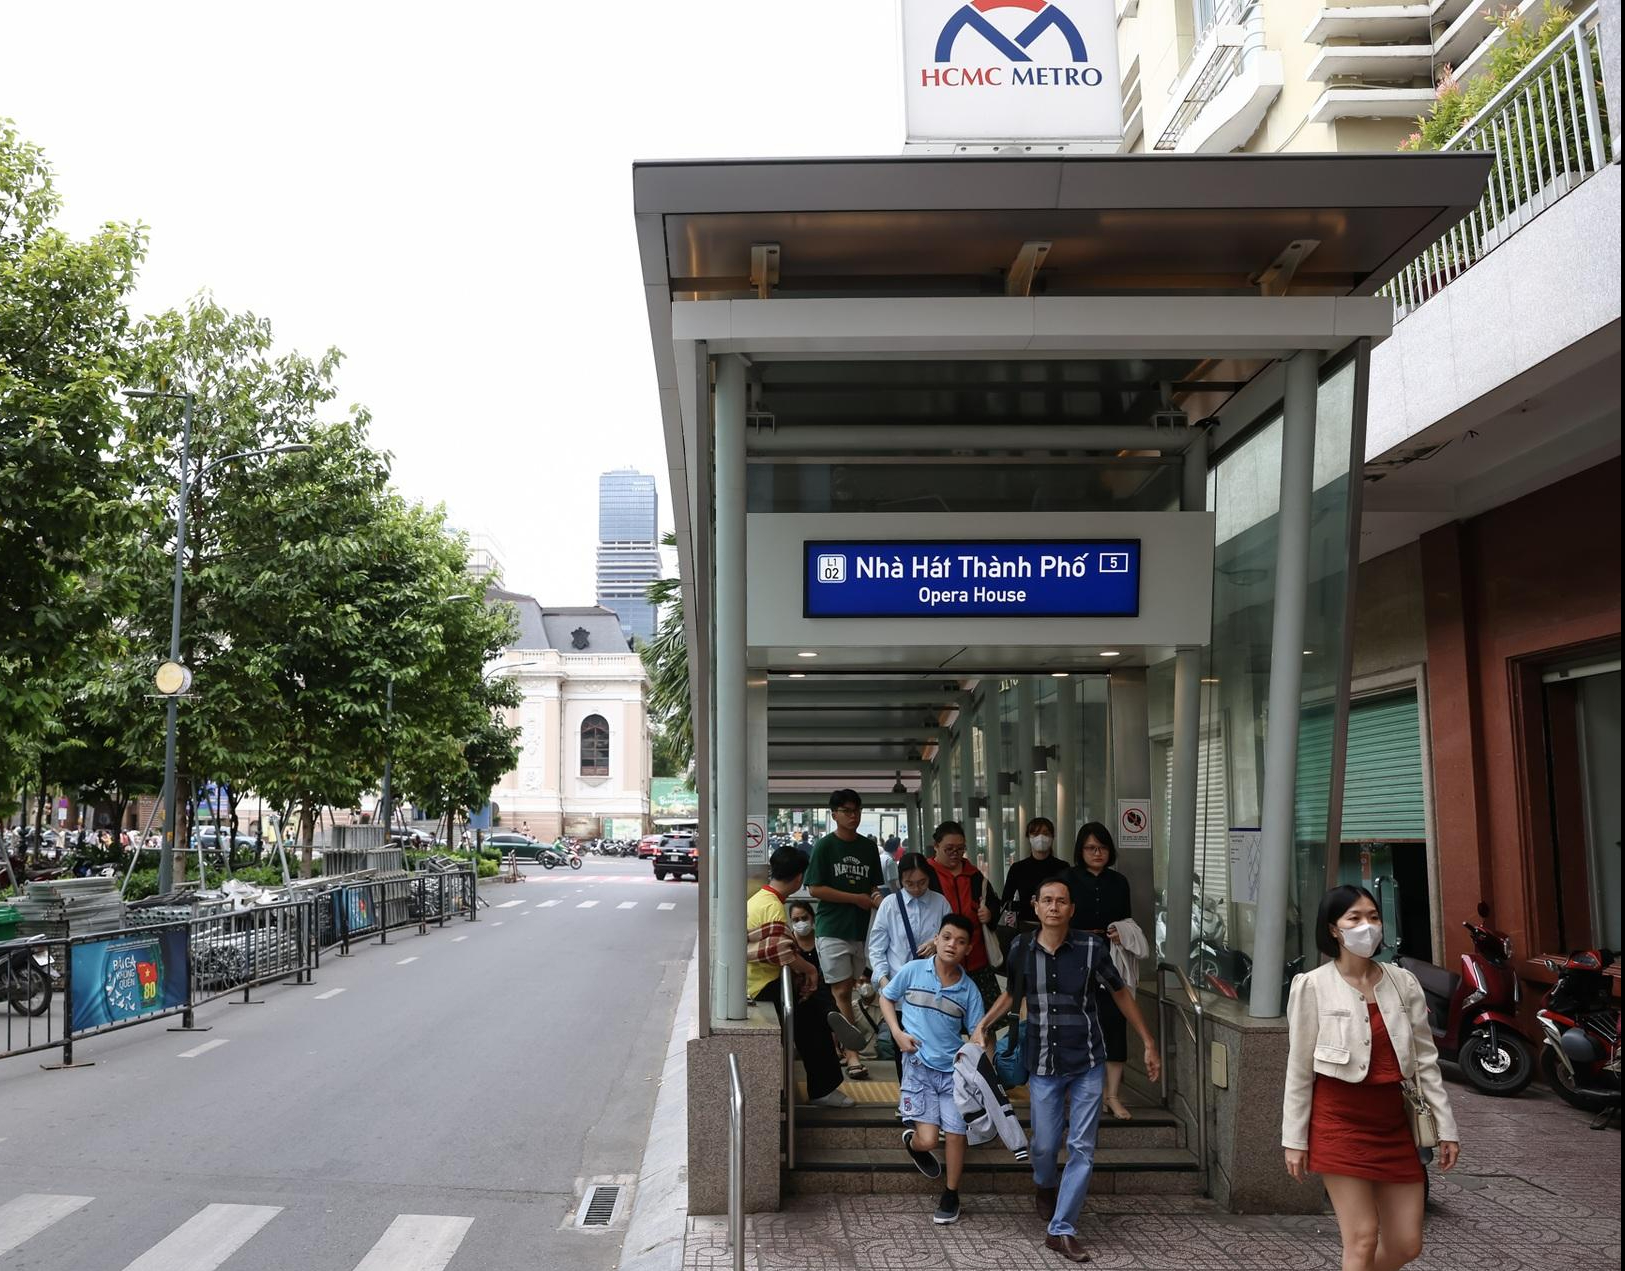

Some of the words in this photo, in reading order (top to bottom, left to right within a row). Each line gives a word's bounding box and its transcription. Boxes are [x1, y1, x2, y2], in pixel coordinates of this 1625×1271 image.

[921, 67, 1001, 87] HCMC
[1012, 67, 1103, 87] METRO
[827, 558, 837, 567] L1
[856, 556, 904, 578] Nhà
[912, 556, 952, 578] Hát
[958, 556, 1032, 578] Thành
[1040, 553, 1089, 578] Phố
[1109, 557, 1118, 569] 5
[824, 568, 839, 580] 02
[919, 587, 969, 607] Opera
[973, 586, 1027, 602] House
[144, 981, 156, 999] 80
